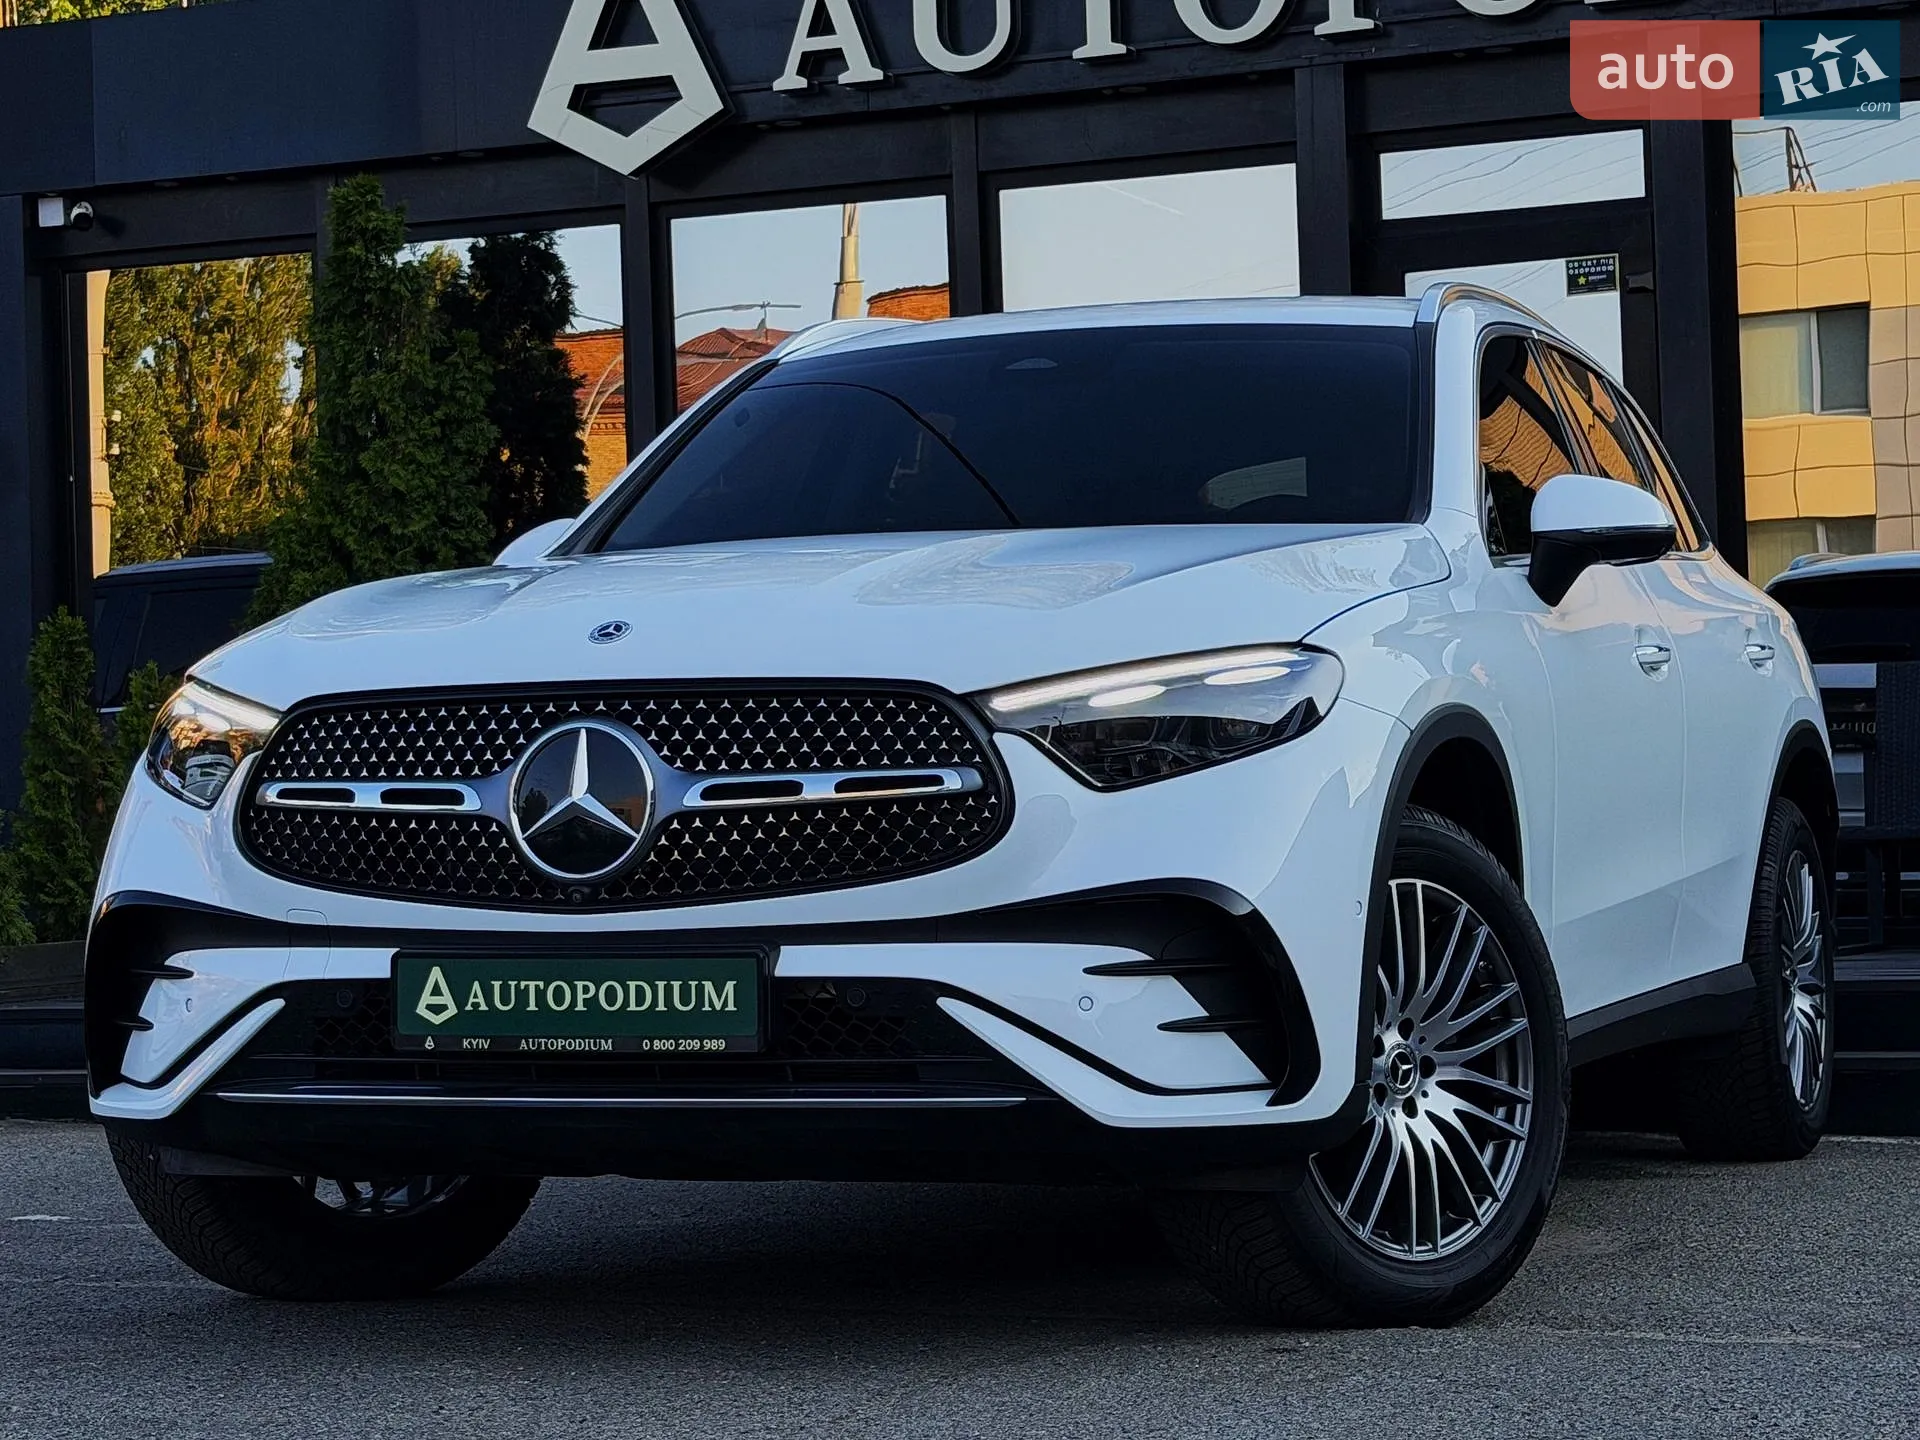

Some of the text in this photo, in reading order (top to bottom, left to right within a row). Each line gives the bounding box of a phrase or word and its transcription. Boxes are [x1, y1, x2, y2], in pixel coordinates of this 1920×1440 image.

[464, 980, 737, 1012] AUTOPODIUM
[463, 1039, 726, 1051] KYIV AUTOPODIUM 0 800 209 989
